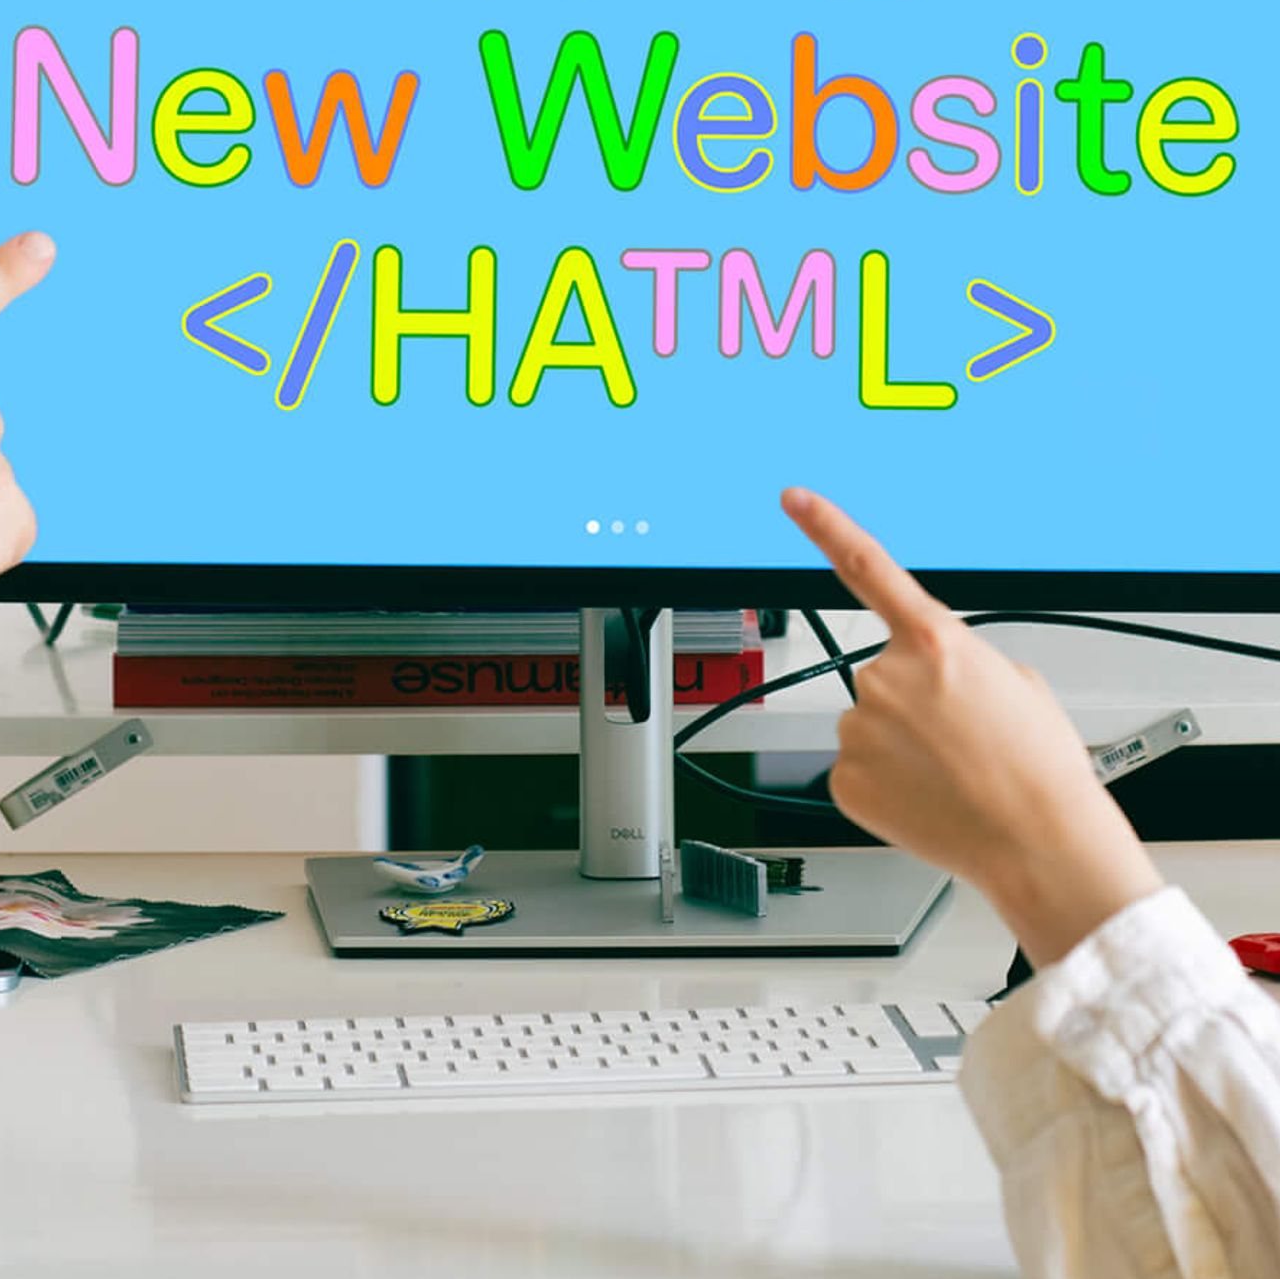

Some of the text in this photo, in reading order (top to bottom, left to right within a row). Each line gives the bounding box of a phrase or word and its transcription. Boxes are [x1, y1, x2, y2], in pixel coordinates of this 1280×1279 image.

[10, 24, 1240, 198] New Website
[610, 827, 646, 840] DELL
